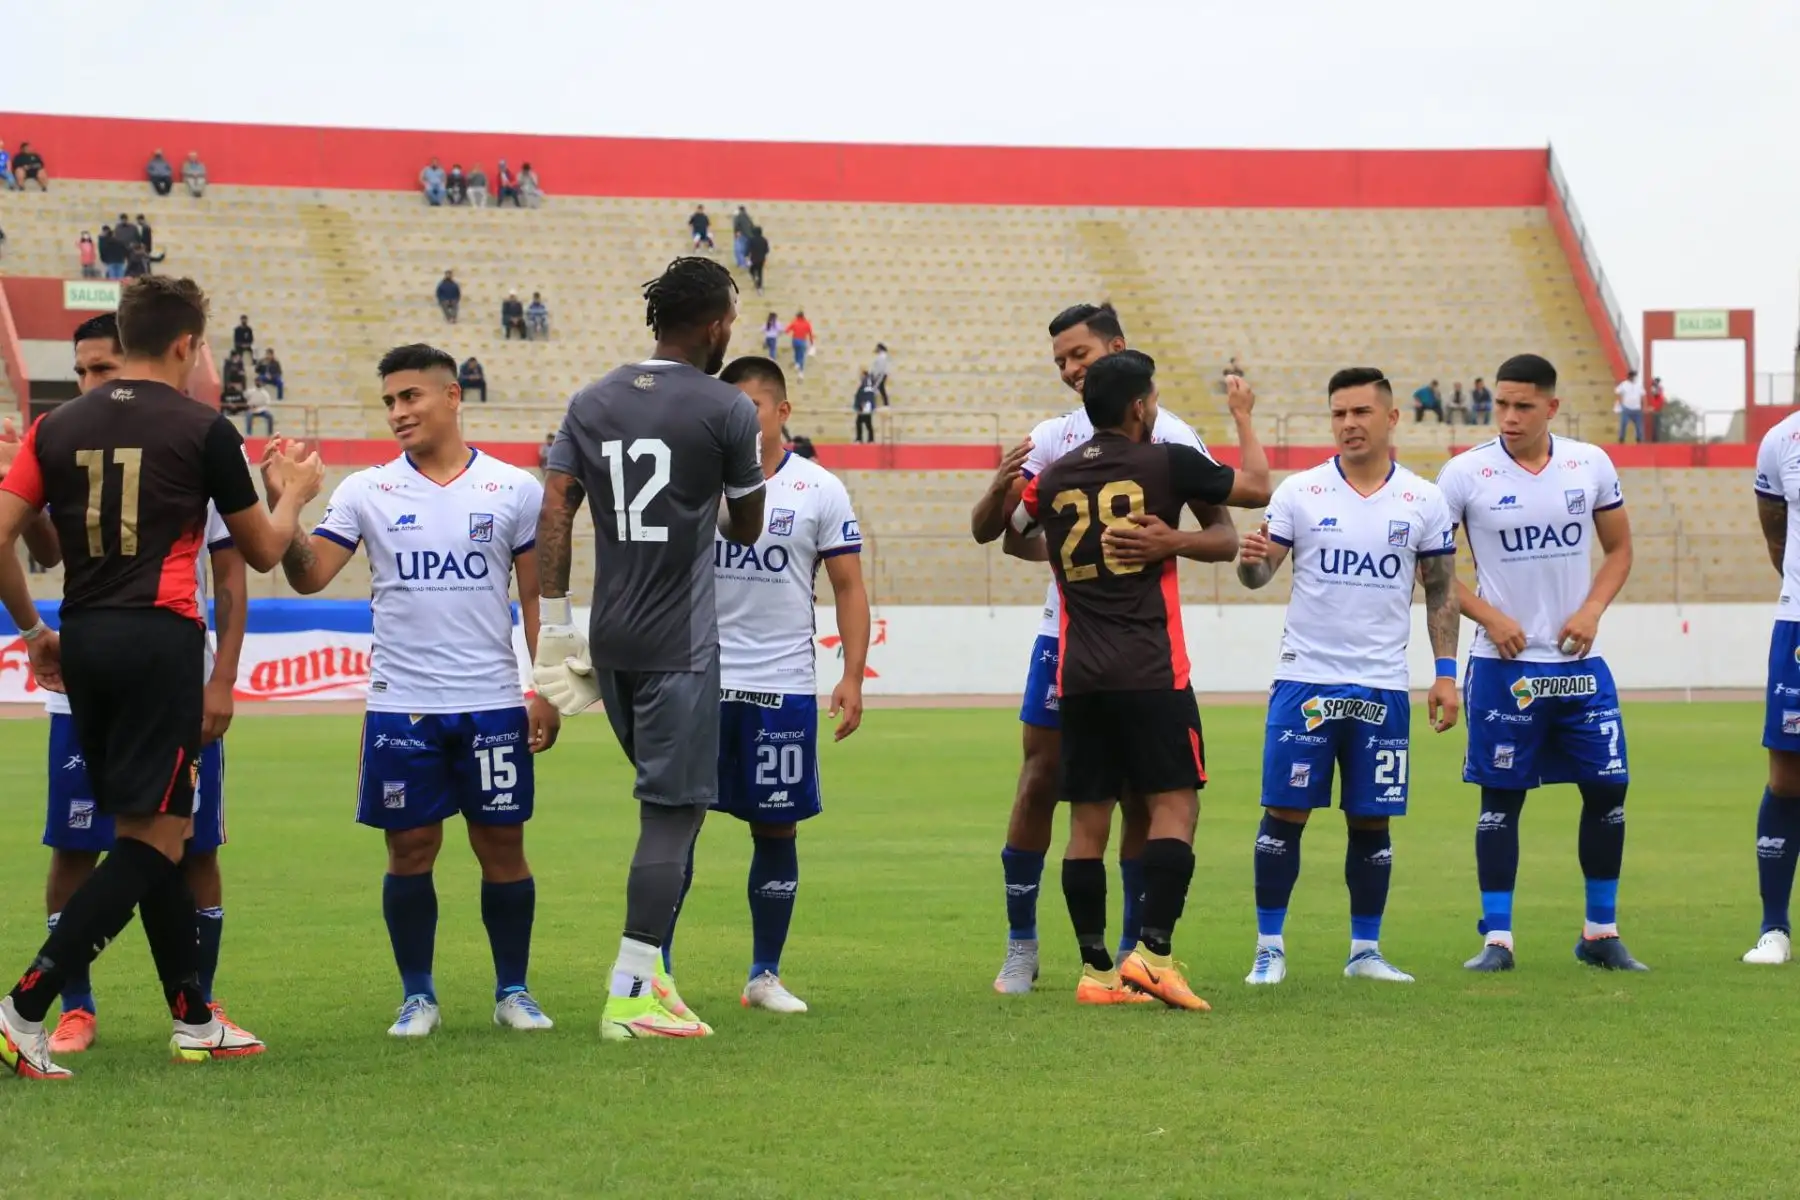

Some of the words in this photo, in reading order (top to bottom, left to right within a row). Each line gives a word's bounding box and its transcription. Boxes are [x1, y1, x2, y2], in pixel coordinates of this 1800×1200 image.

[70, 287, 116, 303] SALIDA
[1679, 317, 1723, 331] SALIDA
[76, 447, 143, 557] 11
[601, 438, 671, 541] 12
[1052, 479, 1146, 583] 28
[1499, 522, 1582, 552] UPAO
[395, 551, 489, 580] UPAO
[1319, 548, 1400, 579] UPAO
[1532, 676, 1595, 696] SPORADE
[1324, 699, 1385, 723] SPORADE
[1600, 720, 1619, 756] 7
[474, 745, 518, 791] 15
[755, 744, 803, 785] 20
[1374, 749, 1407, 784] 21
